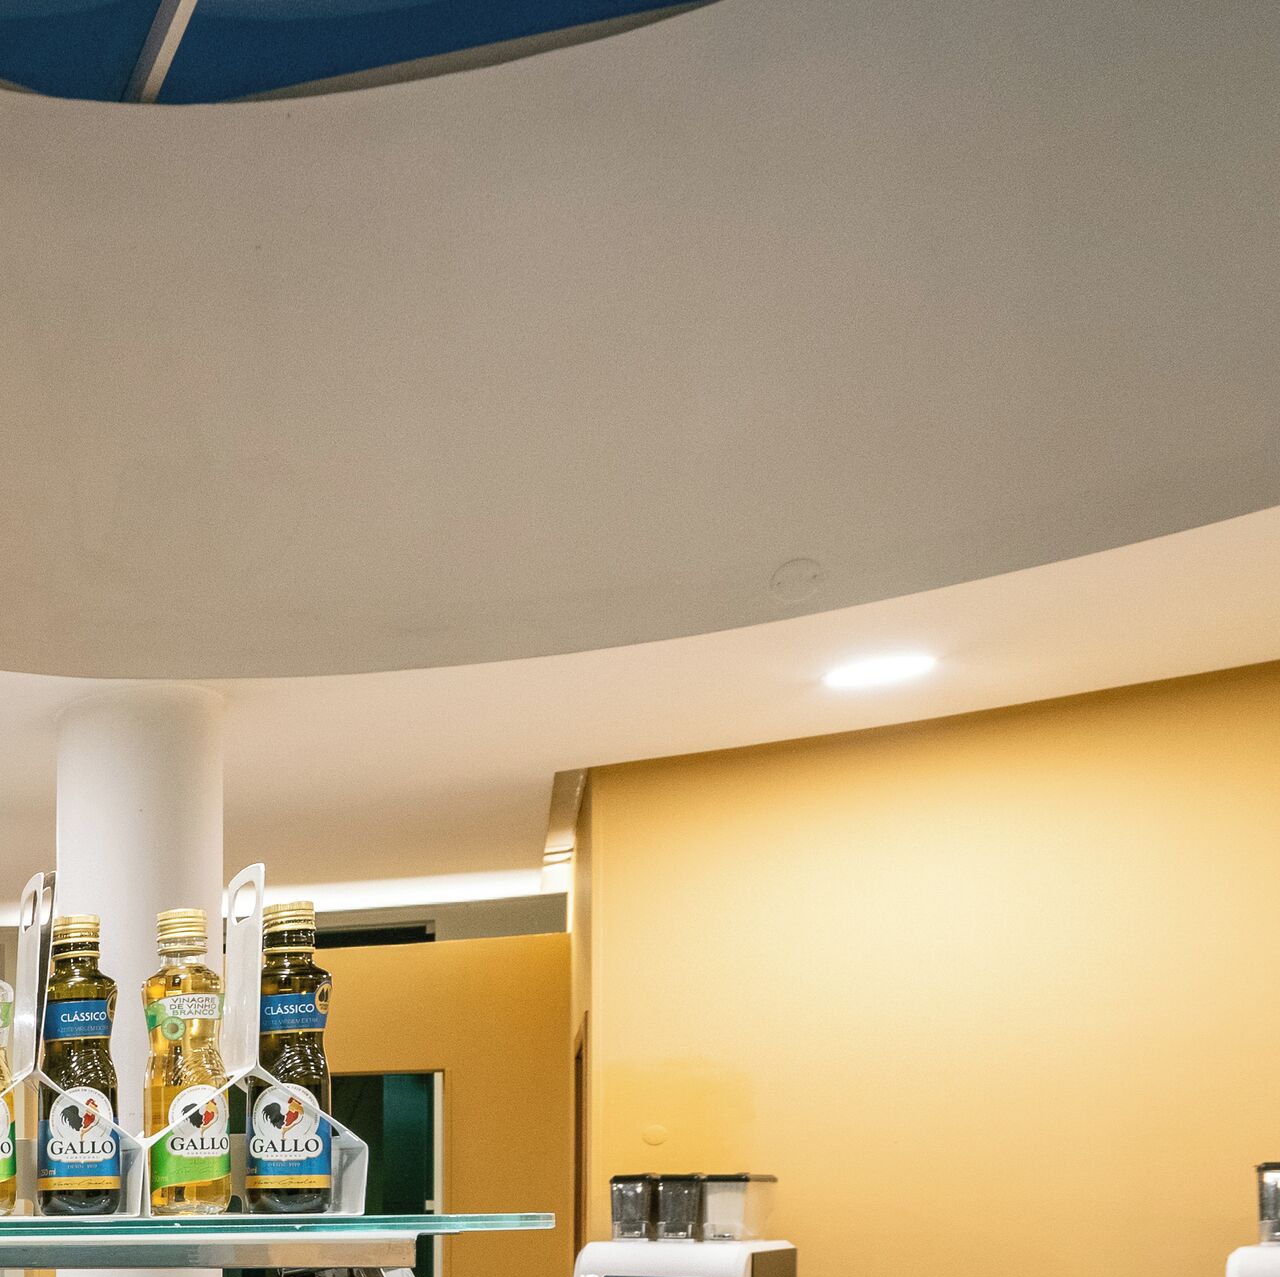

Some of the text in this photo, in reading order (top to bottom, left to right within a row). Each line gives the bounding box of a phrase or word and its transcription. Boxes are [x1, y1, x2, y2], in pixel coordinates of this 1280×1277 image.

[171, 996, 216, 1005] VINAGRE
[185, 1002, 217, 1010] VINHO
[264, 1003, 315, 1016] CLÁSSICO
[60, 1010, 107, 1023] CLÁSSICO
[51, 1140, 114, 1155] GALLO
[170, 1136, 229, 1151] GALLO
[252, 1138, 320, 1153] GALLO
